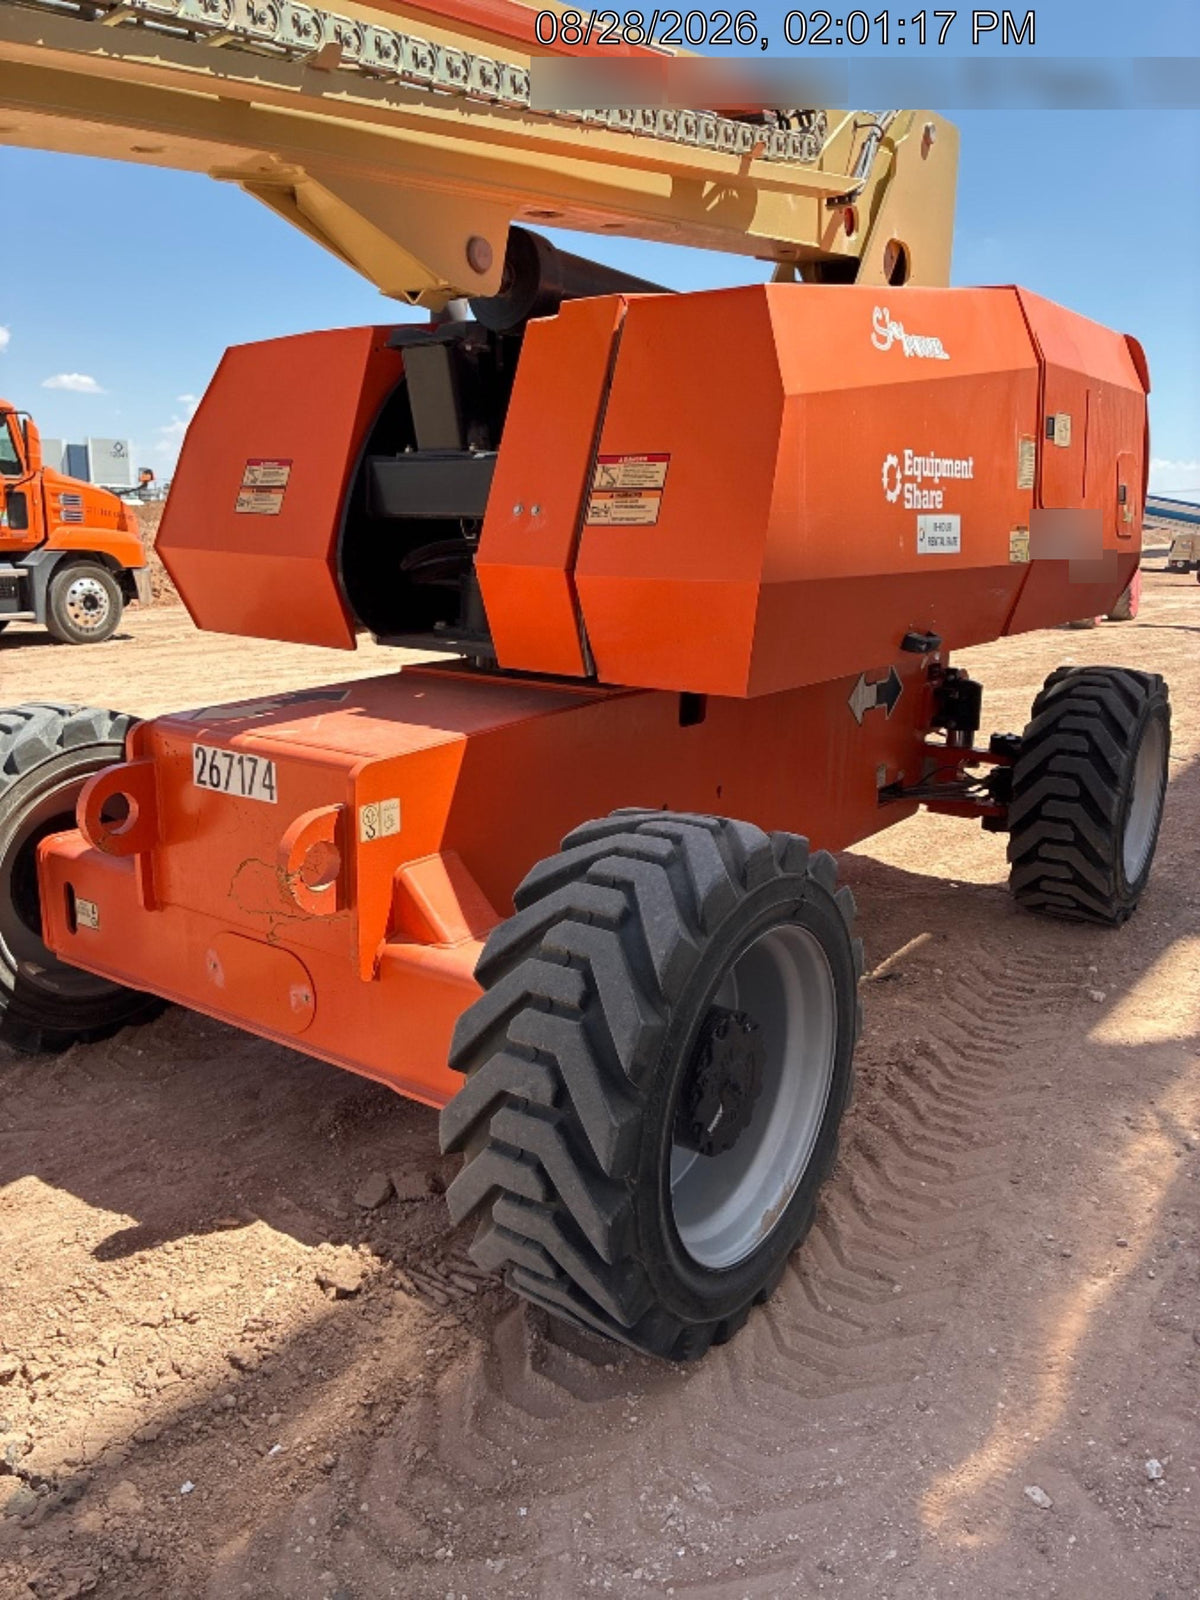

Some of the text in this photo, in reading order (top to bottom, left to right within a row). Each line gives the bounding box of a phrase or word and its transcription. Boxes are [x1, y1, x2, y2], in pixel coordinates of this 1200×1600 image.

[903, 449, 974, 484] Equipment
[903, 483, 943, 509] Share
[195, 746, 274, 801] 267174
